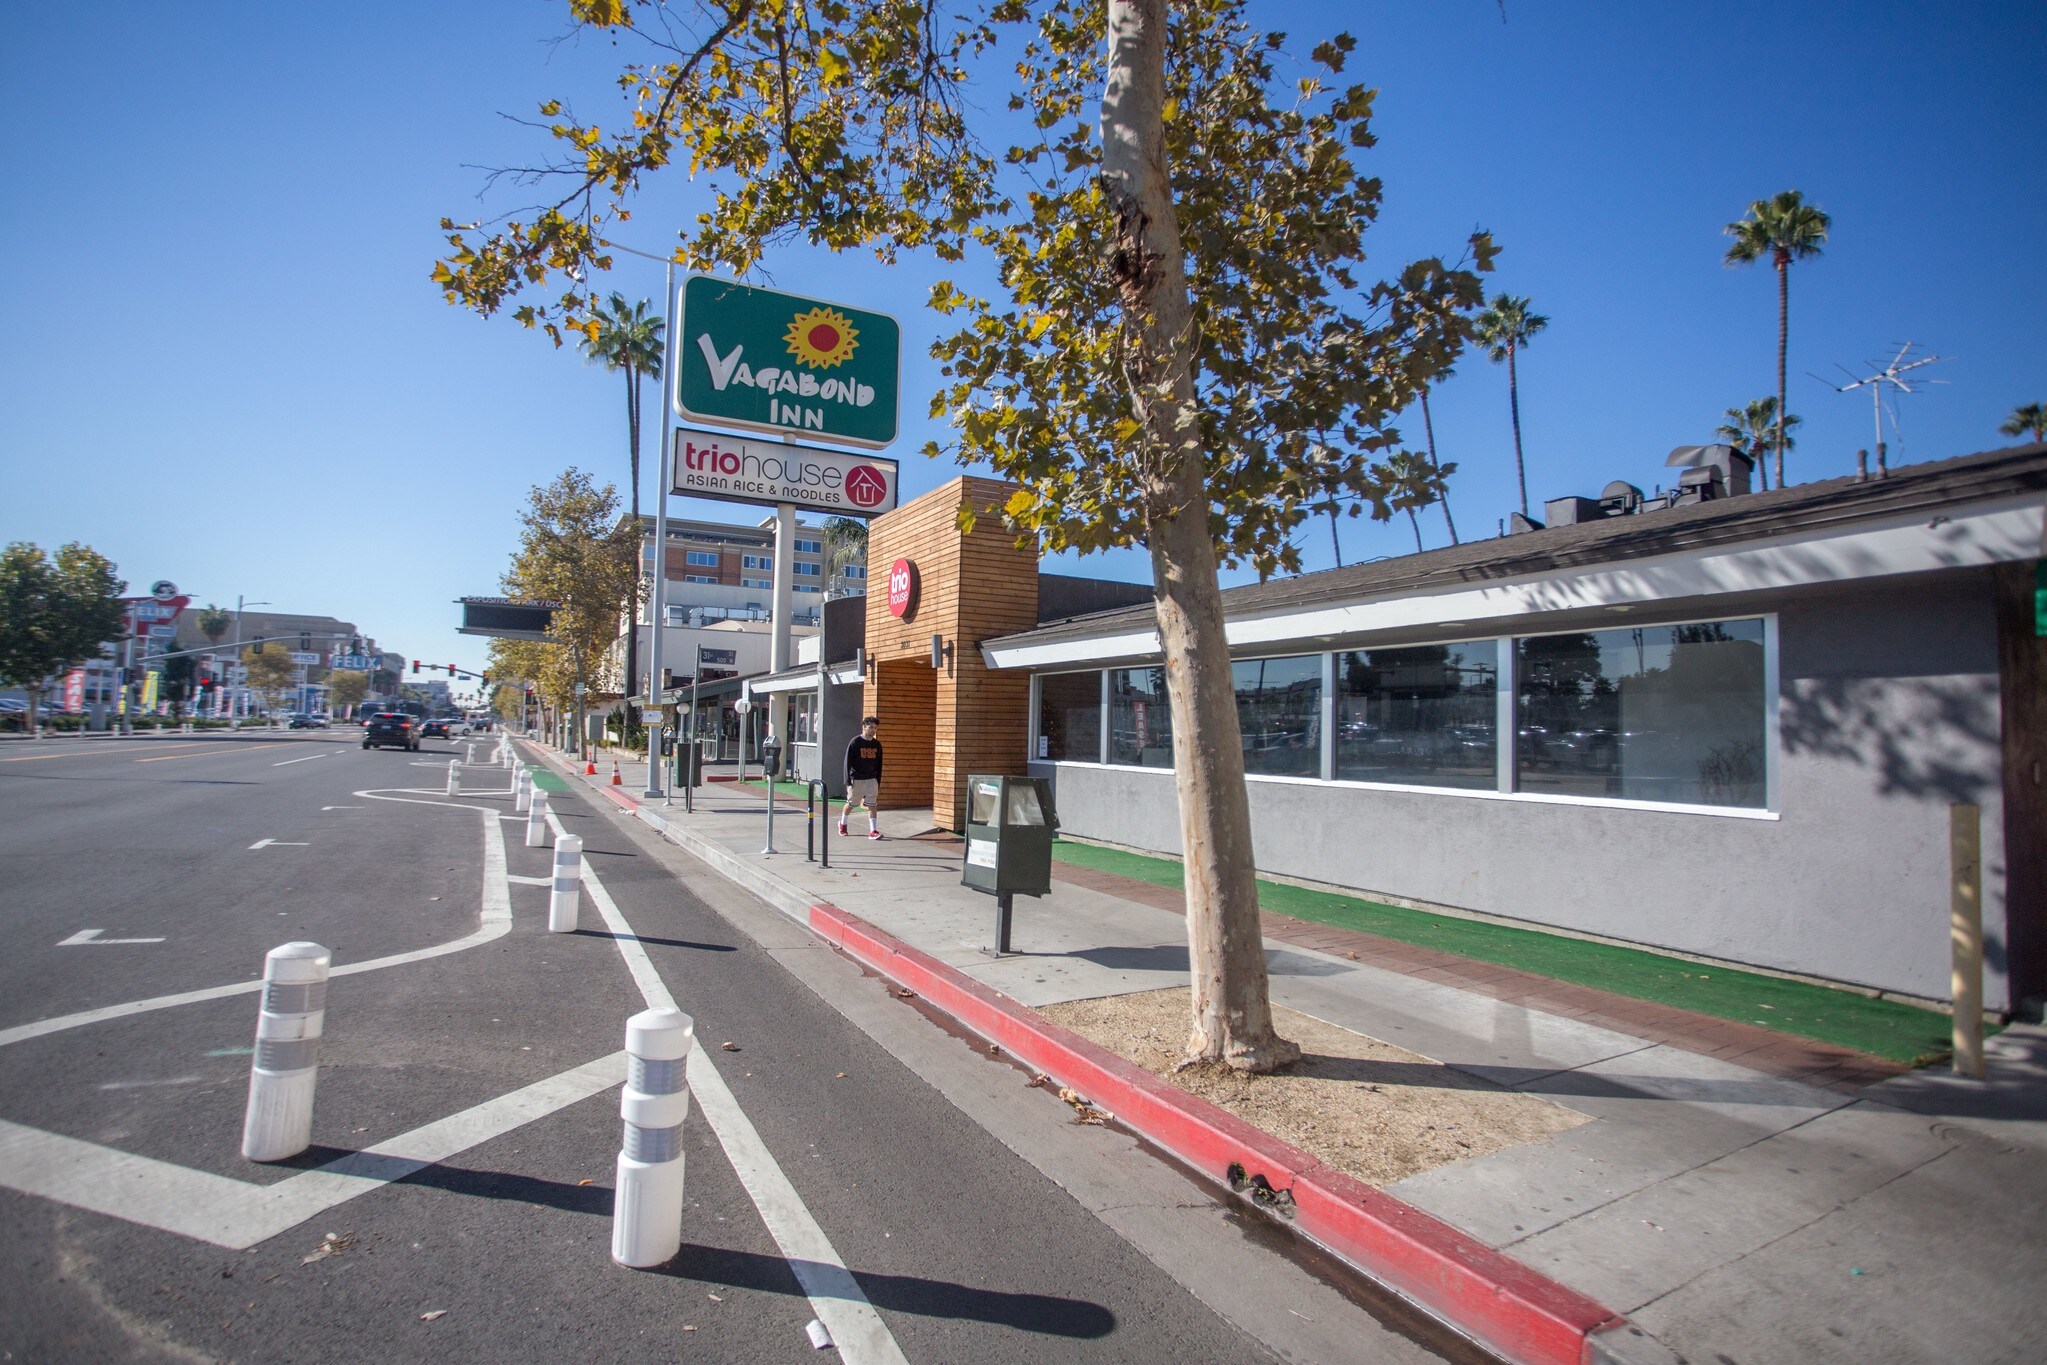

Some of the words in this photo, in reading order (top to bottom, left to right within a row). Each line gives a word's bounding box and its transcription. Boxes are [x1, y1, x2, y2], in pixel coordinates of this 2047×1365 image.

[770, 399, 824, 430] INN
[687, 474, 728, 489] ASIAN
[733, 480, 764, 494] RICE
[768, 485, 777, 495] &
[782, 487, 840, 503] NOODLES
[891, 568, 908, 594] trio
[890, 590, 908, 605] house
[335, 656, 378, 669] FELIX
